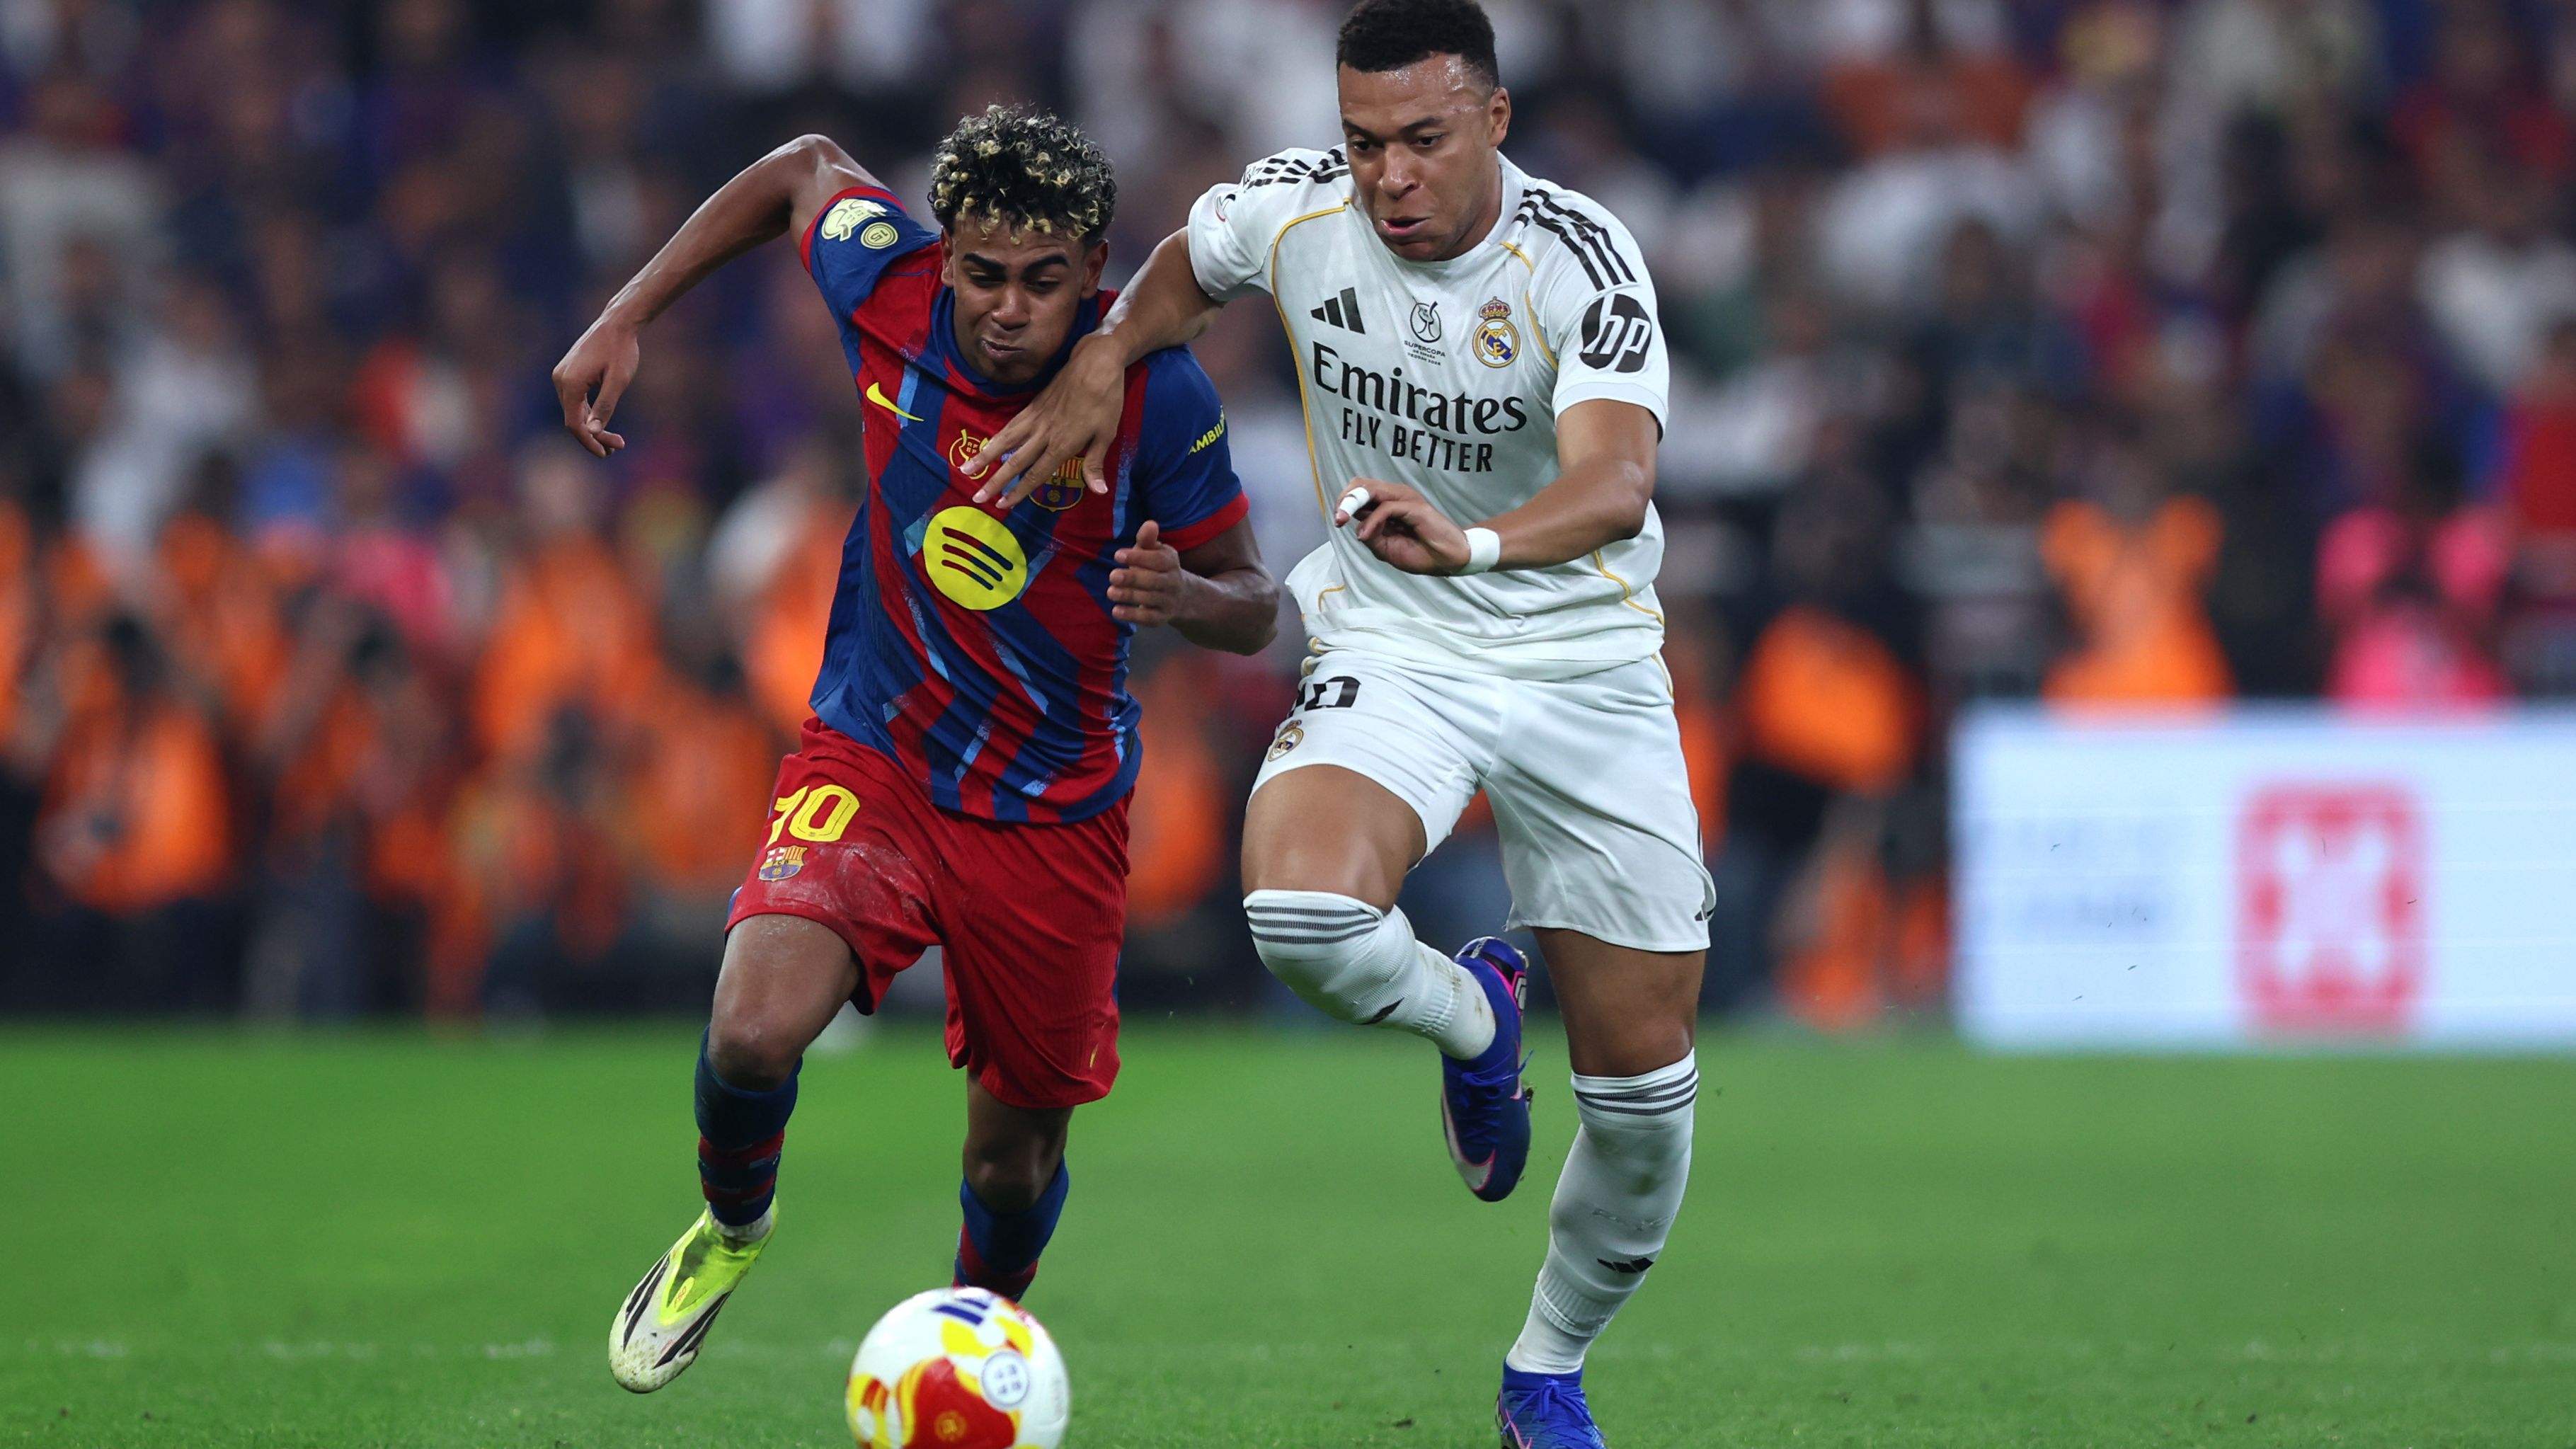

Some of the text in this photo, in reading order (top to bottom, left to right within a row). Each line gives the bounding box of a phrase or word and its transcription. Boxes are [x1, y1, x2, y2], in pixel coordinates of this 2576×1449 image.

[1404, 340, 1446, 357] SUPERCOPA
[1582, 294, 1651, 373] hp
[1312, 340, 1527, 435] Emirates
[1342, 407, 1493, 473] FLY BETTER
[765, 784, 861, 849] 10
